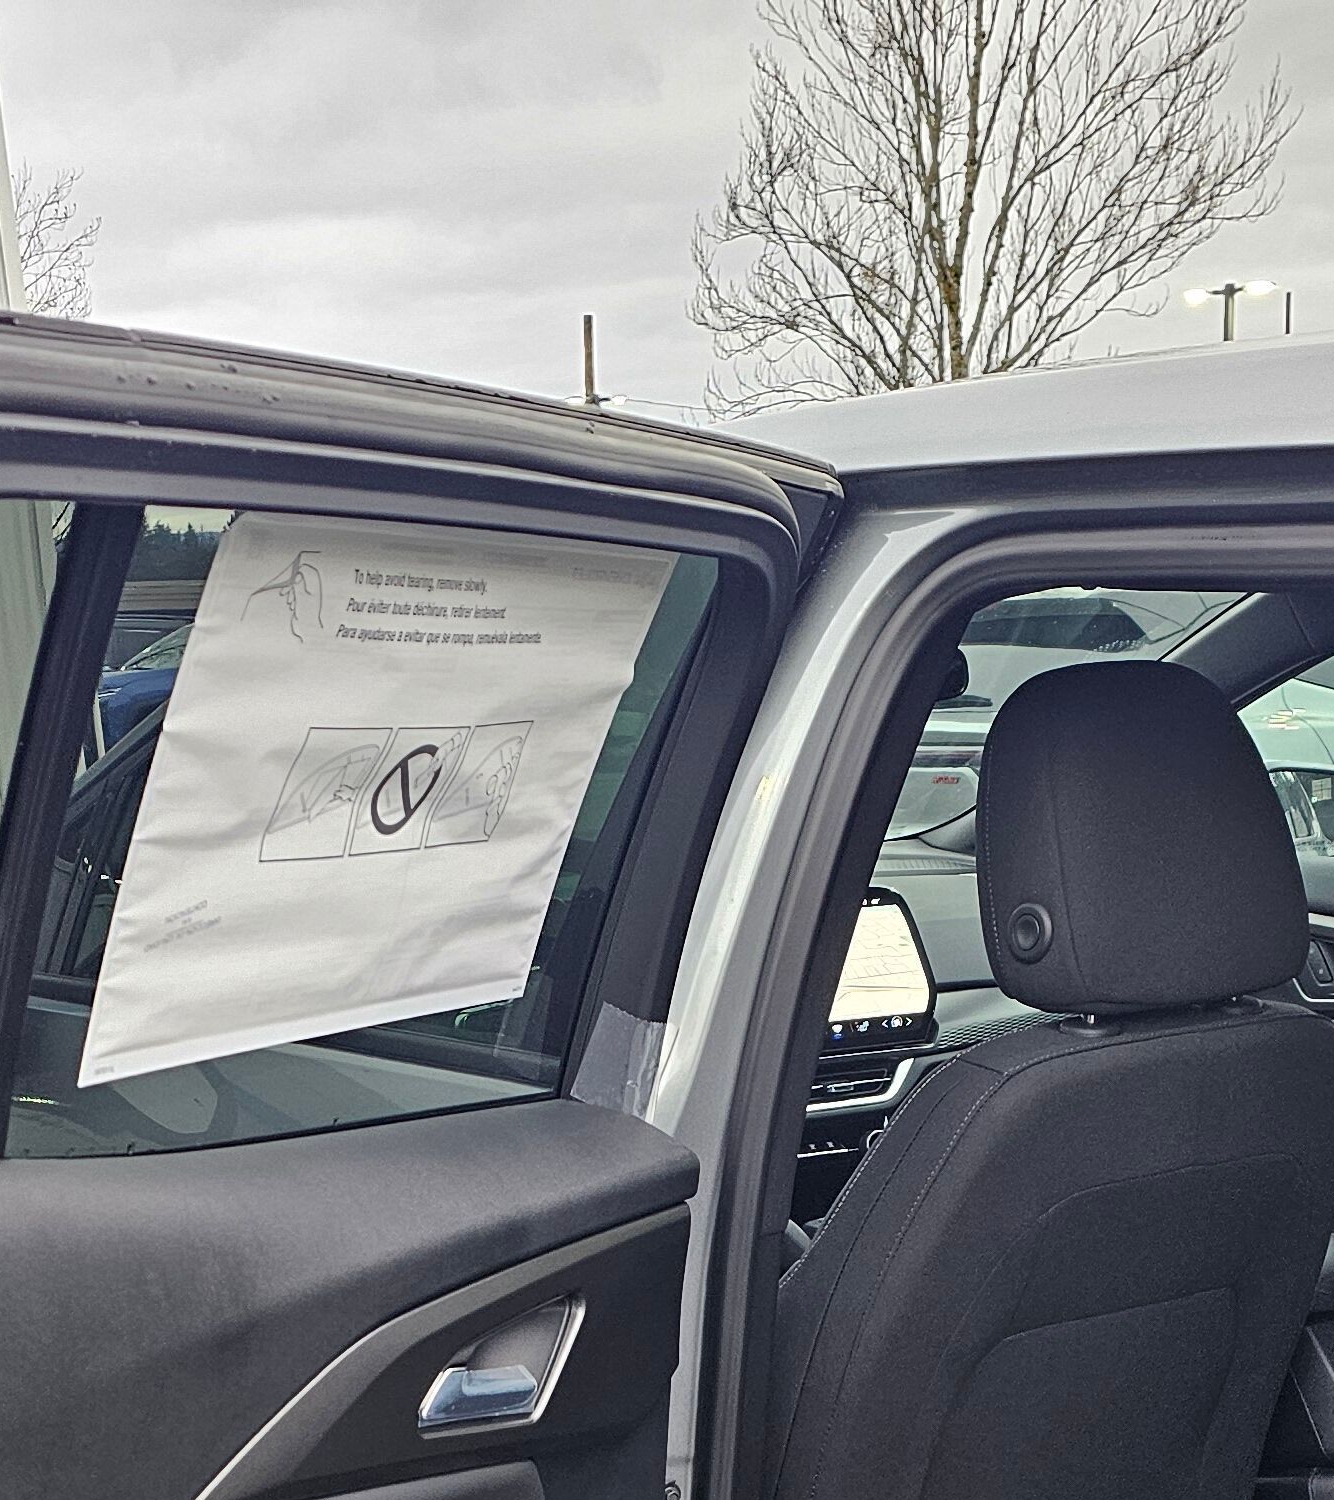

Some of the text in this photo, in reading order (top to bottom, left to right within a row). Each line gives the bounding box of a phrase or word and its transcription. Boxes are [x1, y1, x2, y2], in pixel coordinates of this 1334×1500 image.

[354, 568, 364, 584] To
[366, 569, 383, 588] help
[385, 573, 406, 587] avoid
[436, 578, 464, 591] remove
[347, 597, 367, 613] Pour
[392, 601, 412, 615] toute
[336, 624, 357, 638] Para
